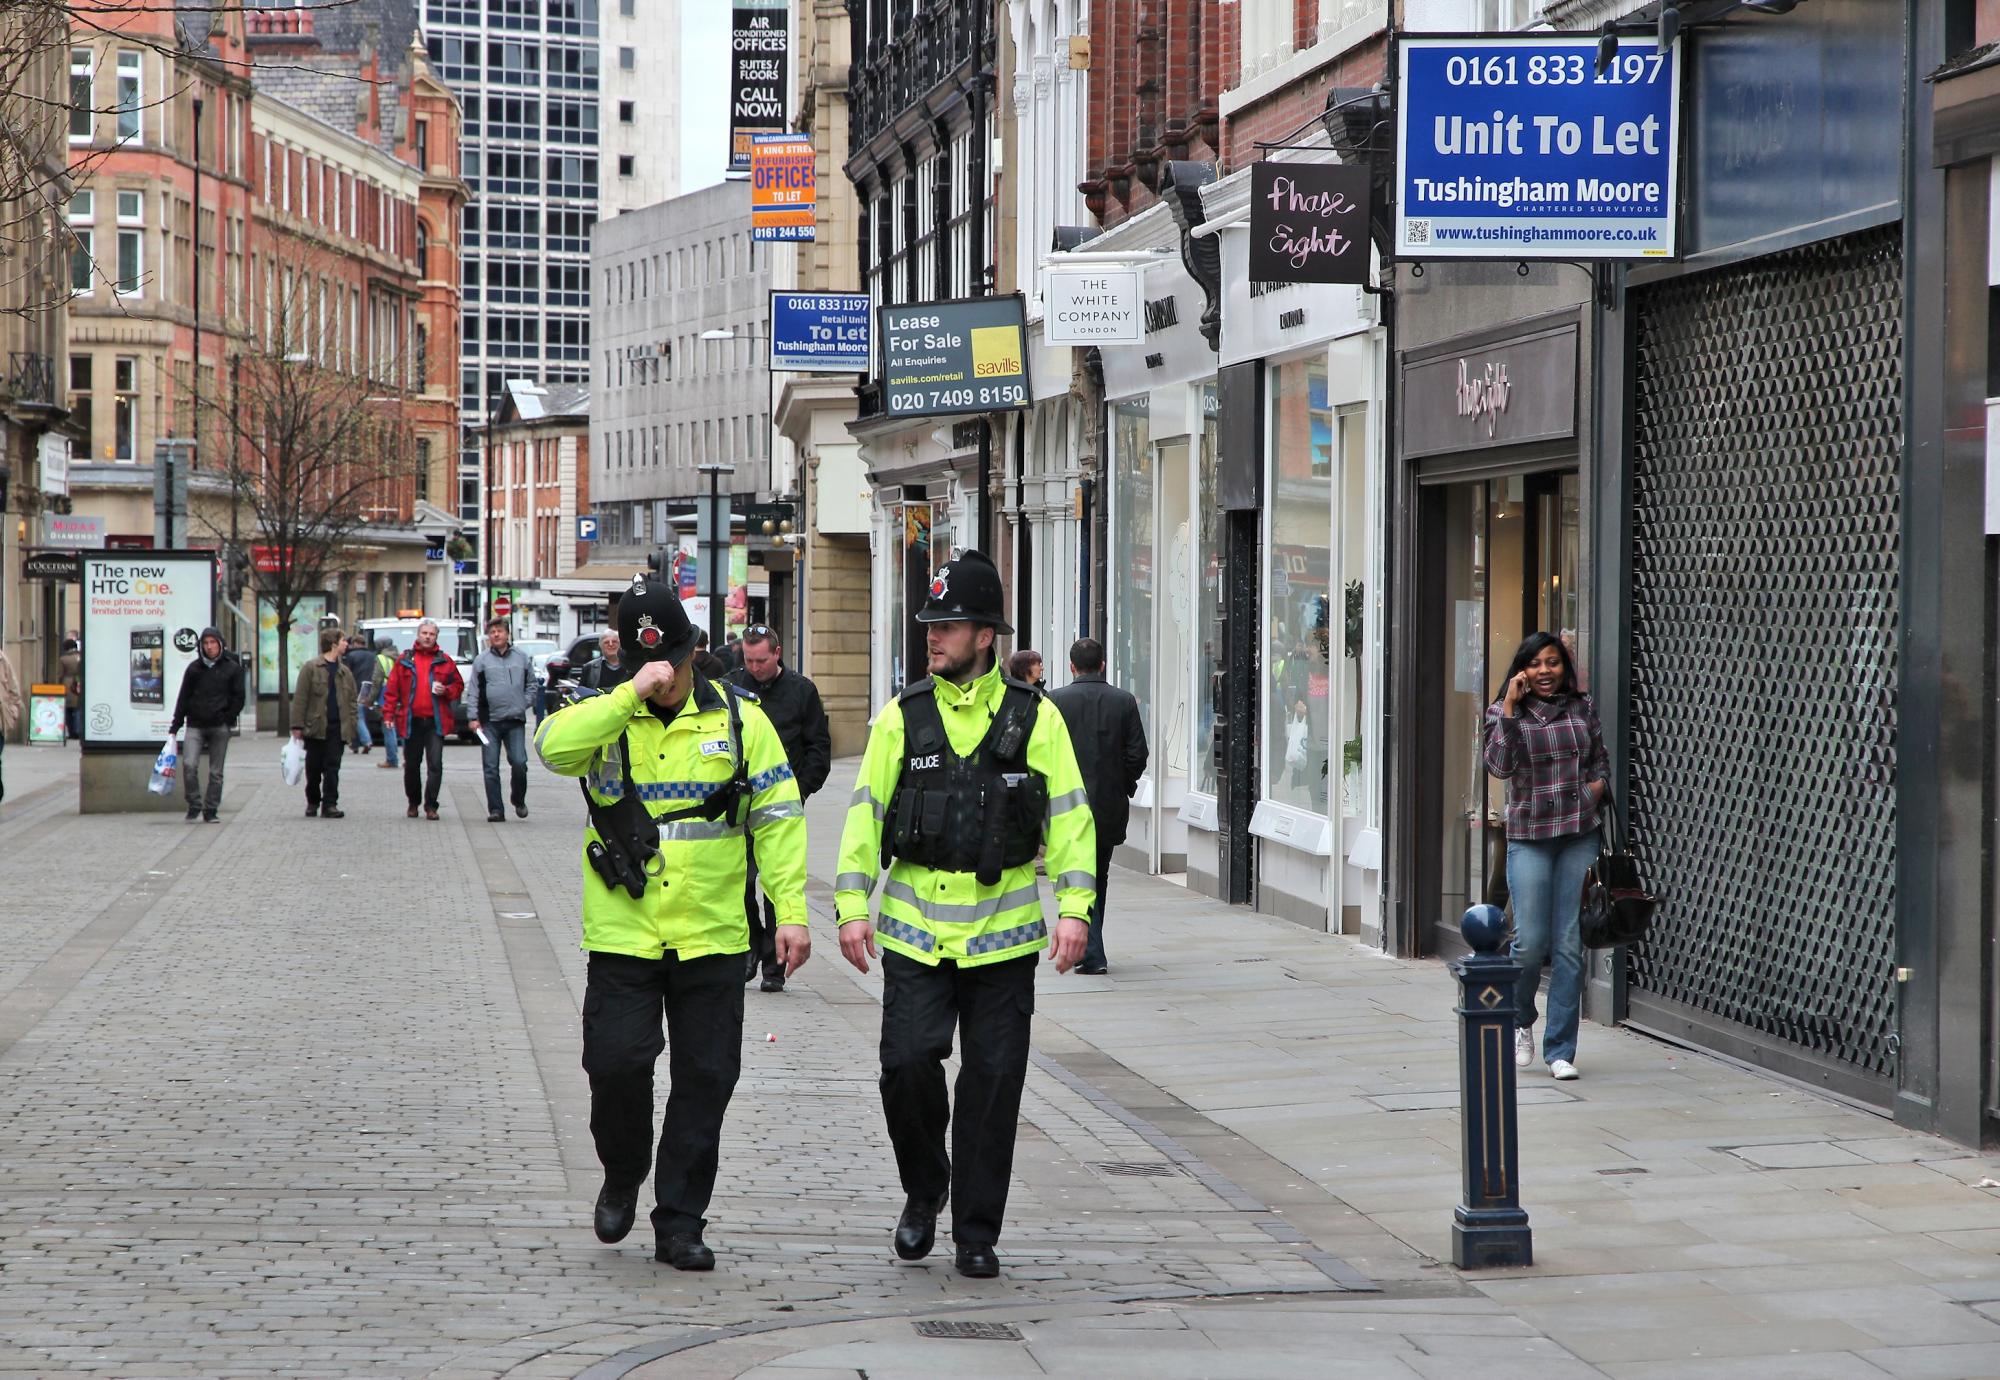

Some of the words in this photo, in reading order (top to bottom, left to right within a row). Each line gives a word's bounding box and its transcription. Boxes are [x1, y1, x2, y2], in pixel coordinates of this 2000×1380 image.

[749, 16, 770, 29] AIR
[733, 29, 786, 38] CONDITIONED
[733, 38, 787, 51] OFFICES
[739, 59, 772, 70] SUITES
[1446, 56, 1519, 86] 0161
[1527, 55, 1585, 85] 833
[740, 70, 779, 80] FLOORS
[740, 87, 778, 102] CALL
[735, 102, 782, 117] NOW!
[1434, 110, 1523, 155] Unit
[1533, 115, 1582, 155] To
[1592, 113, 1660, 155] Let
[735, 153, 750, 161] 0161
[756, 147, 760, 155] 1
[763, 146, 784, 154] KING
[755, 155, 816, 166] REFURBISHE
[773, 191, 783, 202] TO
[786, 190, 801, 202] LET
[1267, 176, 1357, 218] Phase
[1413, 176, 1569, 208] Tushingham
[1577, 178, 1660, 203] Moore
[755, 227, 777, 239] 0161
[779, 226, 796, 238] 244
[798, 226, 815, 237] 550
[1436, 225, 1657, 243] www.tushinghammoore.co.uk
[1269, 223, 1352, 269] Eight
[1081, 279, 1108, 290] THE
[788, 298, 816, 310] 0161
[818, 299, 840, 310] 833
[842, 299, 869, 311] 1197
[1071, 295, 1118, 306] WHITE
[821, 315, 847, 324] Retail
[849, 315, 867, 324] Unit
[889, 315, 940, 331] Lease
[1058, 311, 1130, 322] COMPANY
[809, 325, 833, 340] To
[836, 326, 868, 341] Let
[776, 341, 836, 353] Tushingham
[837, 342, 868, 352] Moore
[890, 336, 920, 352] For
[924, 333, 962, 350] Sale
[890, 358, 903, 367] All
[905, 356, 947, 368] Enquiries
[976, 357, 1020, 375] savills
[890, 371, 964, 386] savills.com/retail
[891, 392, 924, 411] 020
[929, 388, 974, 408] 7409
[979, 384, 1024, 404] 8150
[54, 521, 96, 531] MIDAS
[580, 520, 596, 538] P
[91, 563, 124, 578] The
[130, 566, 165, 578] new
[92, 580, 129, 595] HTC
[135, 579, 173, 595] One.
[91, 598, 111, 606] Free
[114, 598, 141, 607] phone
[144, 598, 156, 606] for
[91, 607, 121, 615] limited
[123, 607, 144, 615] time
[703, 742, 729, 753] POLIC
[911, 754, 940, 771] POLICE
